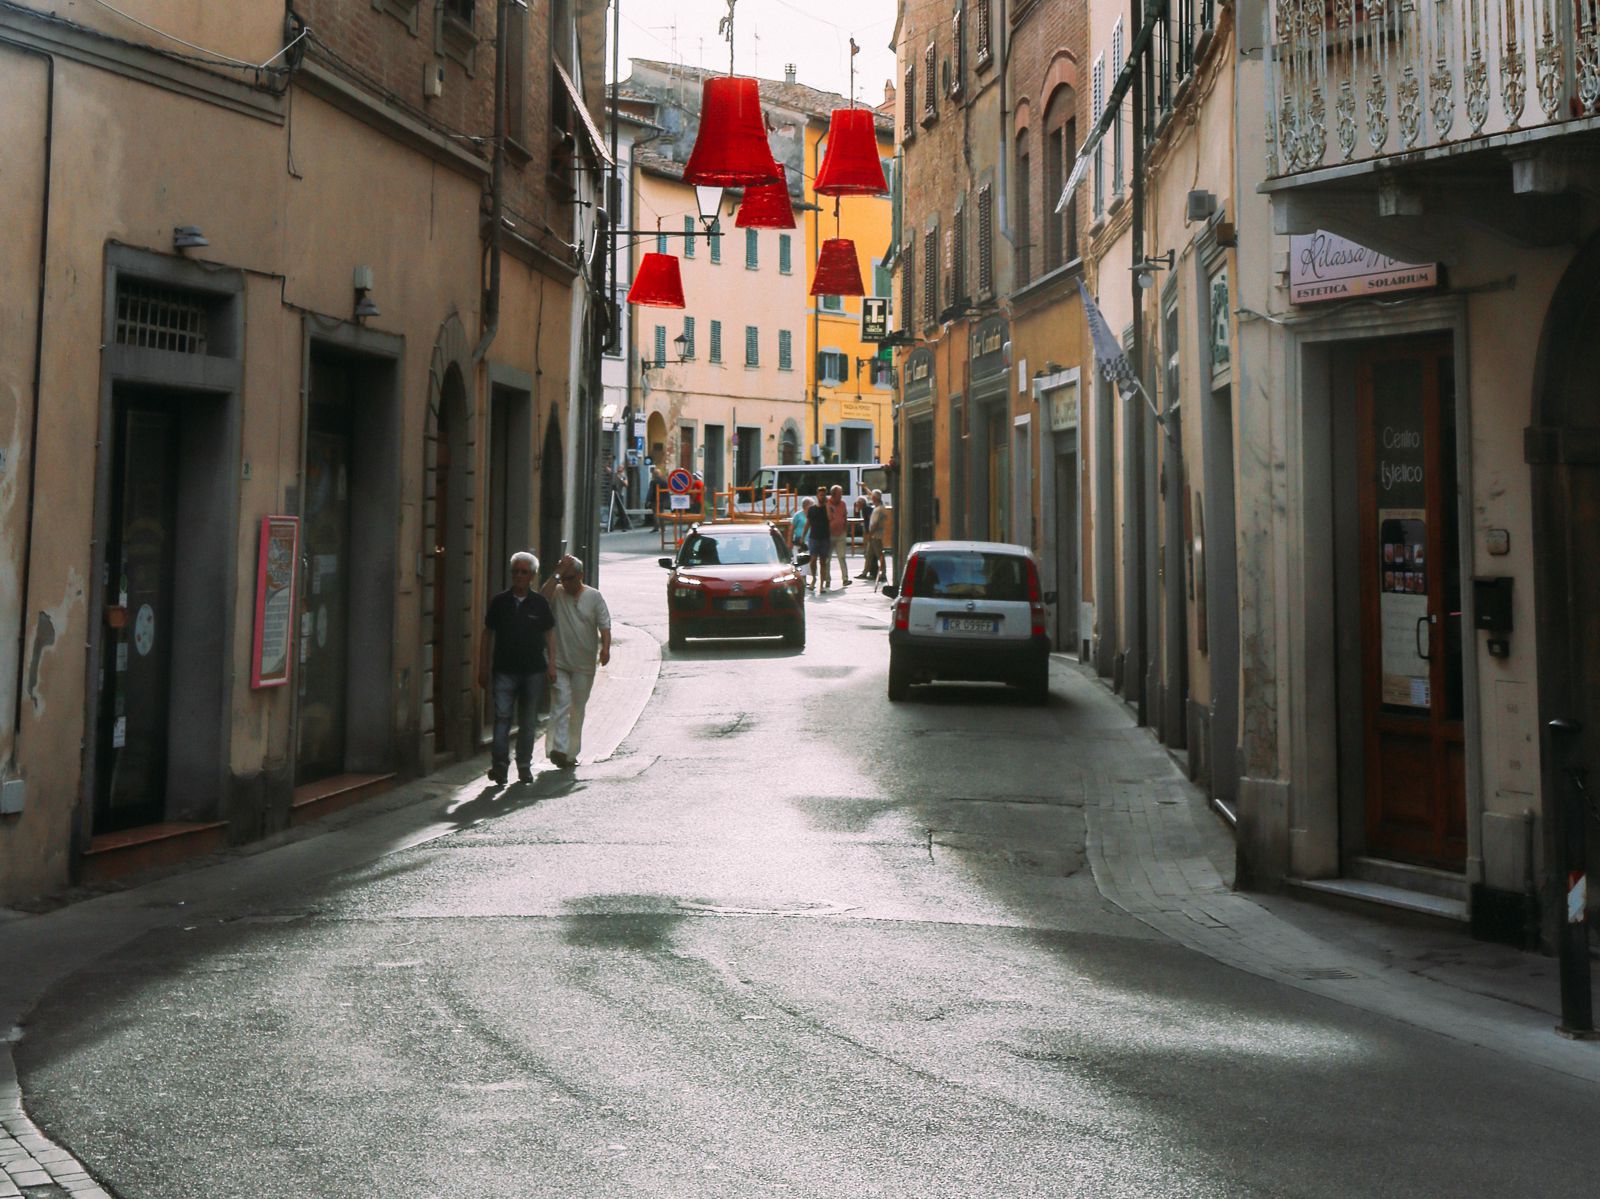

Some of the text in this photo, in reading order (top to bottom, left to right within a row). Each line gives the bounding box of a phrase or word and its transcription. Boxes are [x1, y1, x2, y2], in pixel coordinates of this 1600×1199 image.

[1297, 273, 1429, 298] ESTETICA SOLARIUM
[867, 300, 883, 323] T
[1383, 426, 1420, 449] Centro
[1381, 460, 1423, 490] Estetico
